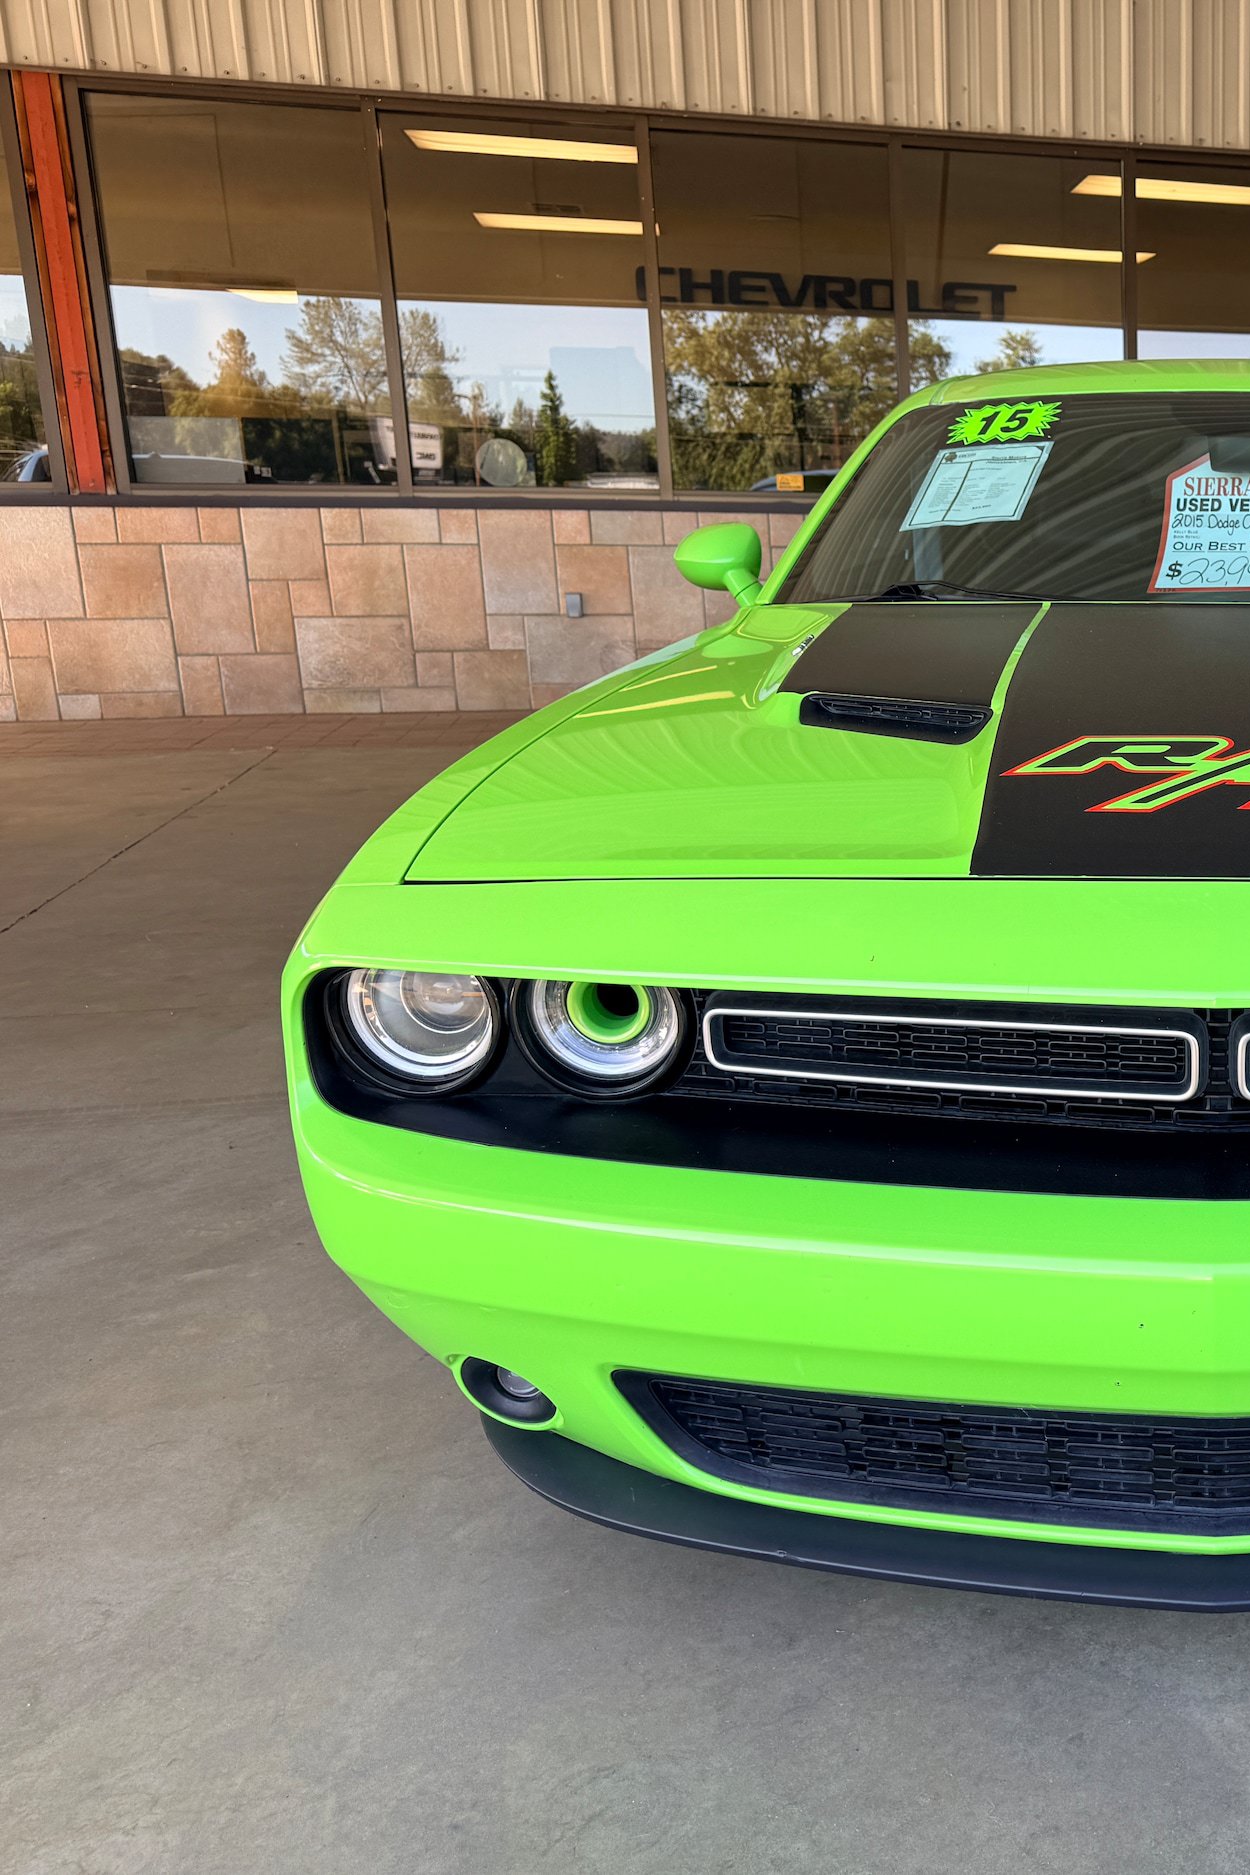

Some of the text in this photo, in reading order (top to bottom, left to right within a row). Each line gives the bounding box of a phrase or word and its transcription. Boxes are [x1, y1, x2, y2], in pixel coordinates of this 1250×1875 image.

[636, 265, 1017, 320] CHEVROLET
[978, 408, 1035, 436] 15
[1176, 498, 1222, 512] USED
[1172, 513, 1204, 529] 2015
[1208, 514, 1240, 535] Dodge
[1172, 541, 1202, 551] OUR
[1208, 541, 1245, 551] BEST
